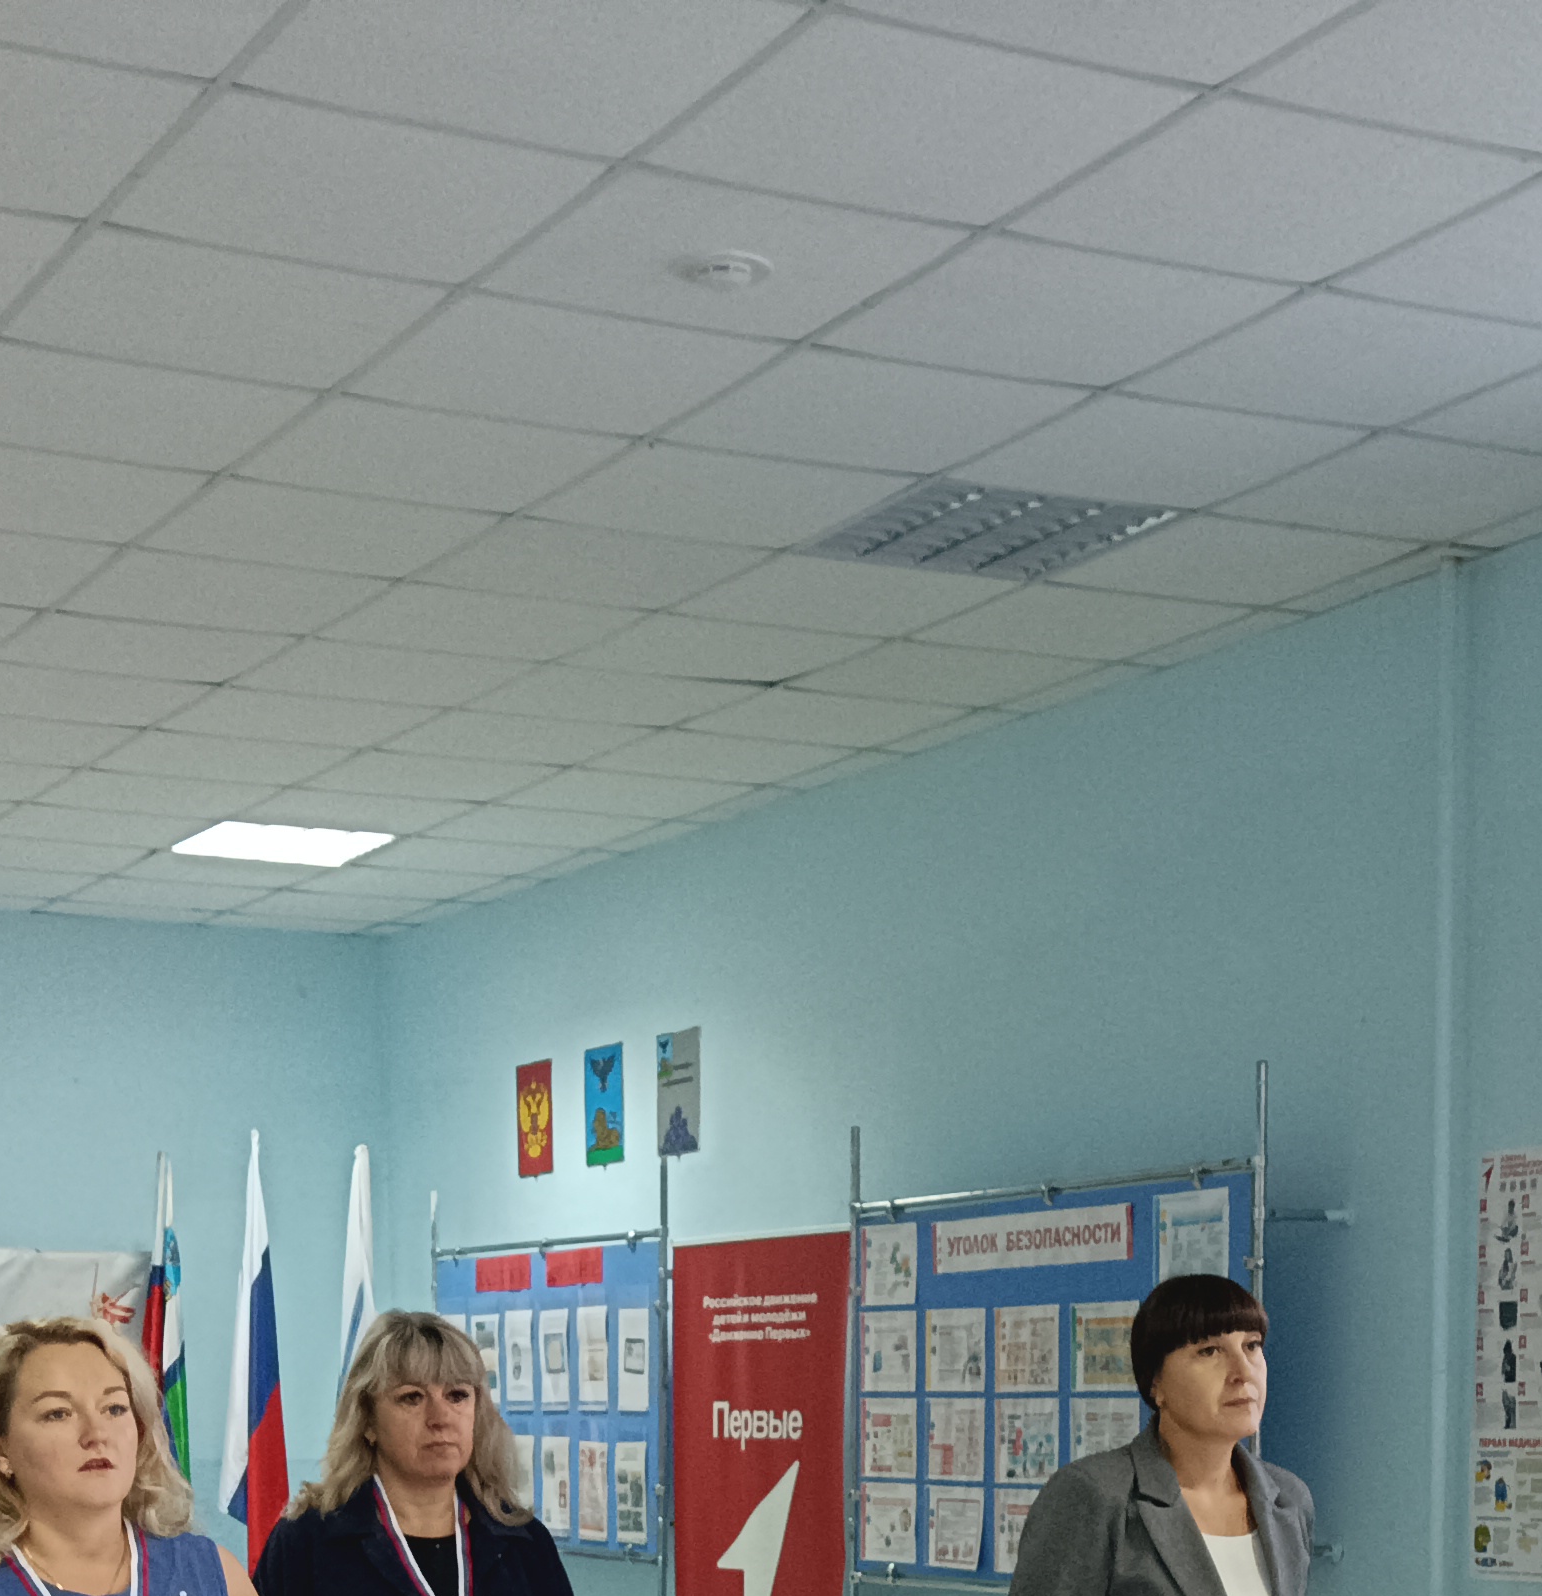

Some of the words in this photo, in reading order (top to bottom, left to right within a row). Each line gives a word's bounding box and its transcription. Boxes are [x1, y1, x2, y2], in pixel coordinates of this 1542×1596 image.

[947, 1233, 998, 1257] УГОЛОК
[1006, 1222, 1121, 1252] БЕЗОПАСНОСТИ
[713, 1401, 803, 1451] Первые
